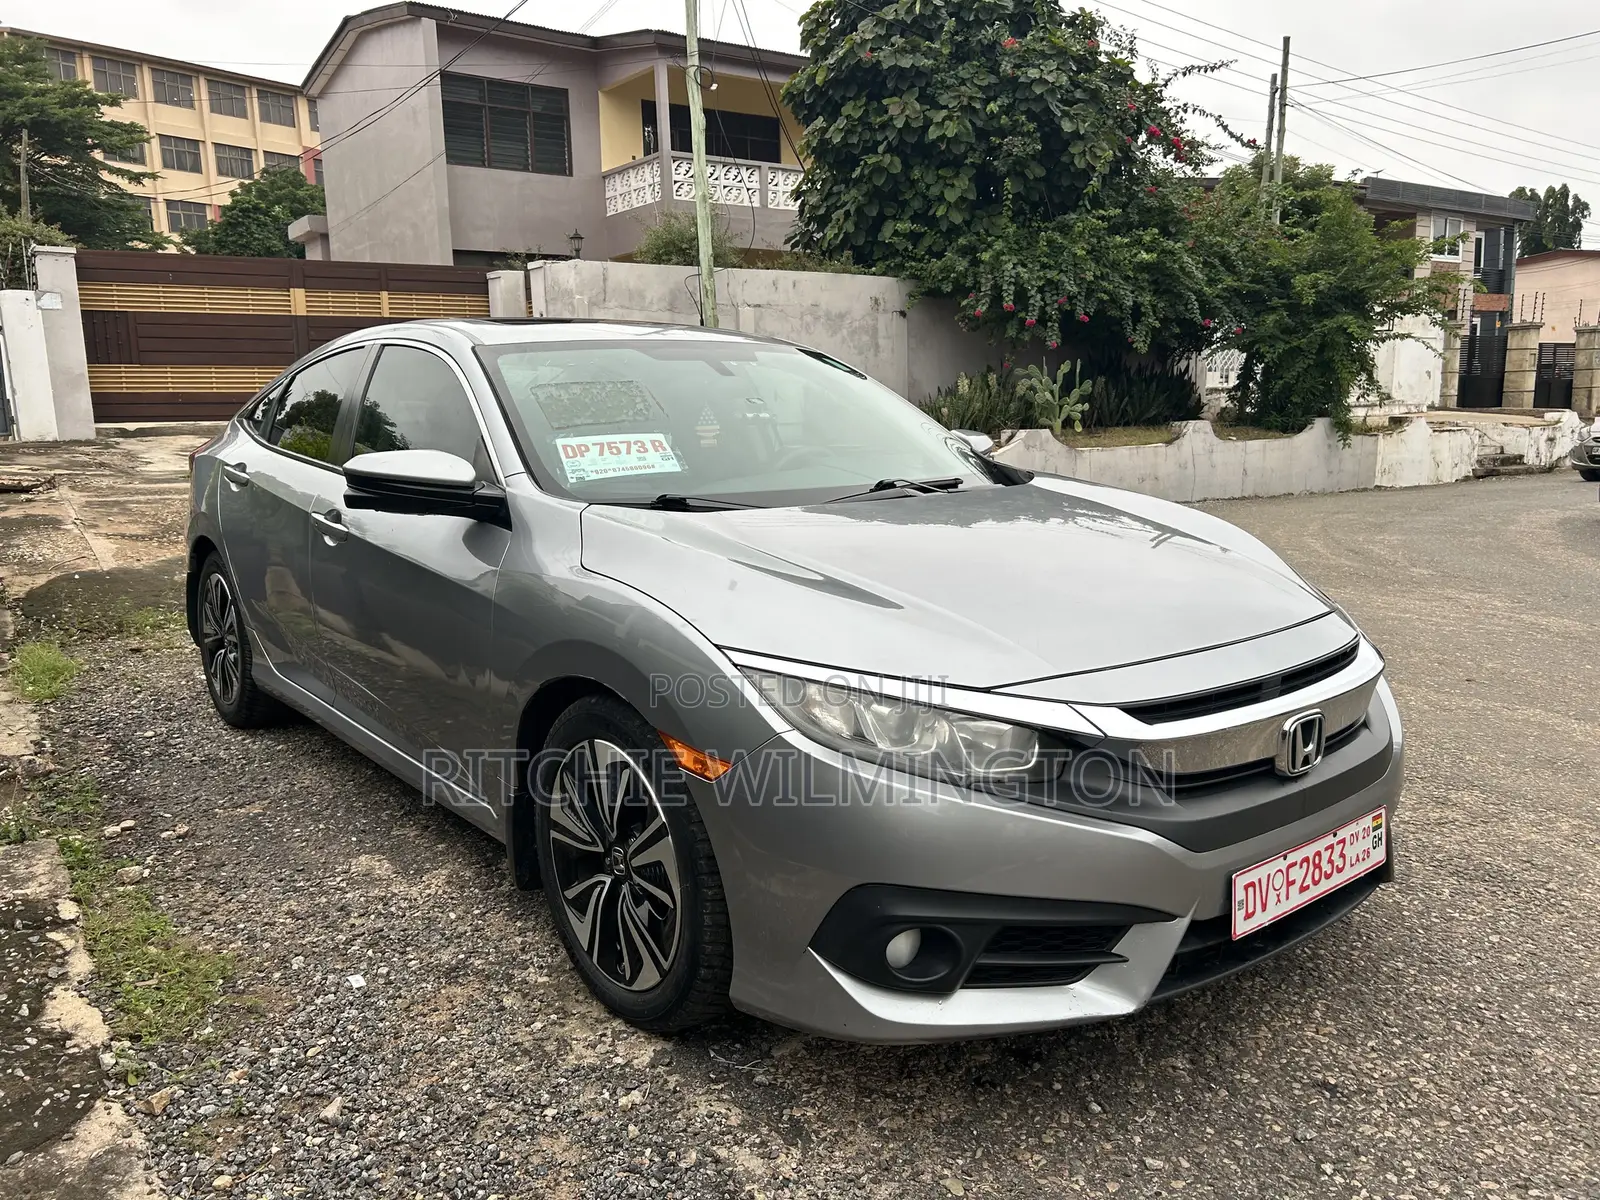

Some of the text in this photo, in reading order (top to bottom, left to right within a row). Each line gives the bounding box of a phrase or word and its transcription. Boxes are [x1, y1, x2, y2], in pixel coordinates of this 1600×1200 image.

[561, 439, 667, 459] DP 7573 R
[1349, 825, 1371, 846] DV 20
[1371, 831, 1383, 850] GH
[1349, 847, 1371, 868] LA 26
